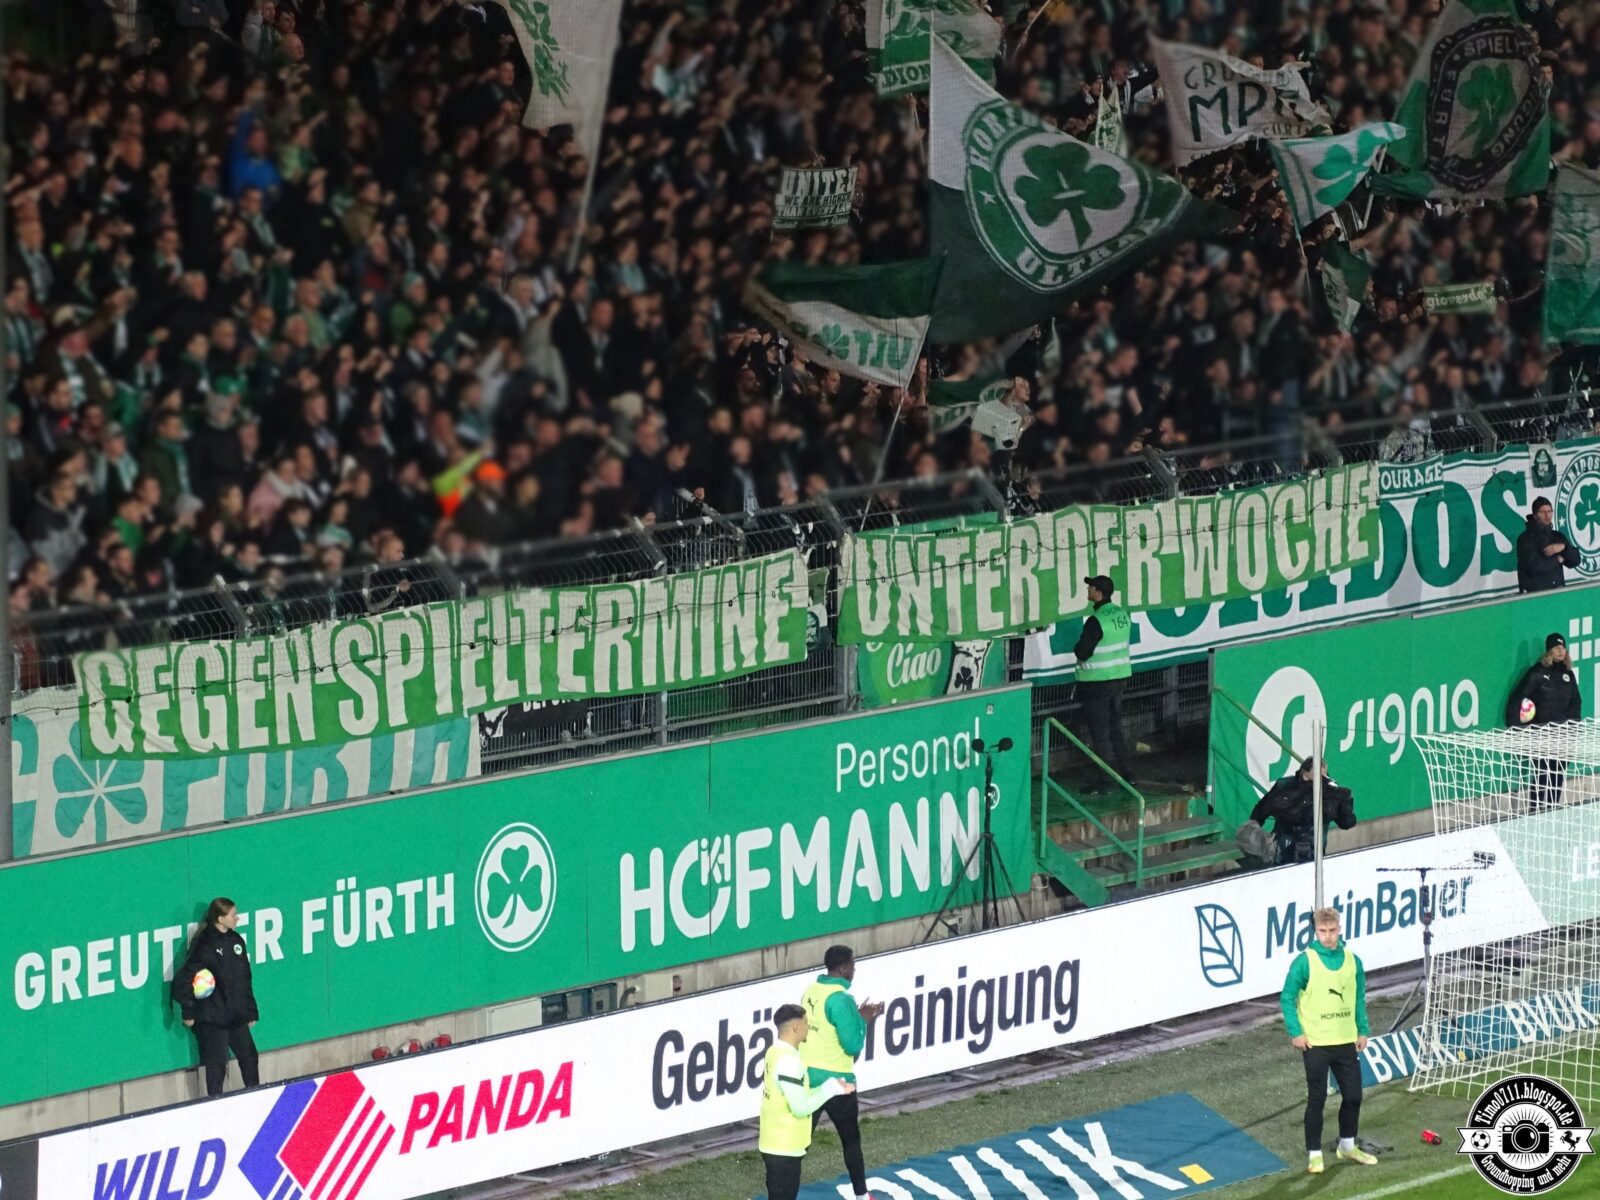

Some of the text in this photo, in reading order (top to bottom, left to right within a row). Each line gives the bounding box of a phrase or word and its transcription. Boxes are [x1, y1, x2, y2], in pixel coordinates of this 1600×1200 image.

[1380, 462, 1443, 491] OURAGE
[84, 633, 315, 755] GEGEN
[333, 552, 802, 736] SPIELTERMINE
[854, 518, 1040, 637] UNTER
[1055, 502, 1162, 615] DER
[1163, 465, 1375, 599] WOCHE
[1111, 615, 1129, 630] 164
[886, 642, 932, 688] Ciao
[836, 716, 980, 793] Personal
[1339, 679, 1479, 765] signia
[620, 786, 981, 953] HOFMANN
[14, 873, 455, 1010] GREUTR FÜRTH
[1265, 875, 1474, 960] MainBauer
[652, 958, 1081, 1111] Gebäreinigung
[93, 1060, 574, 1200] WILD PANDA
